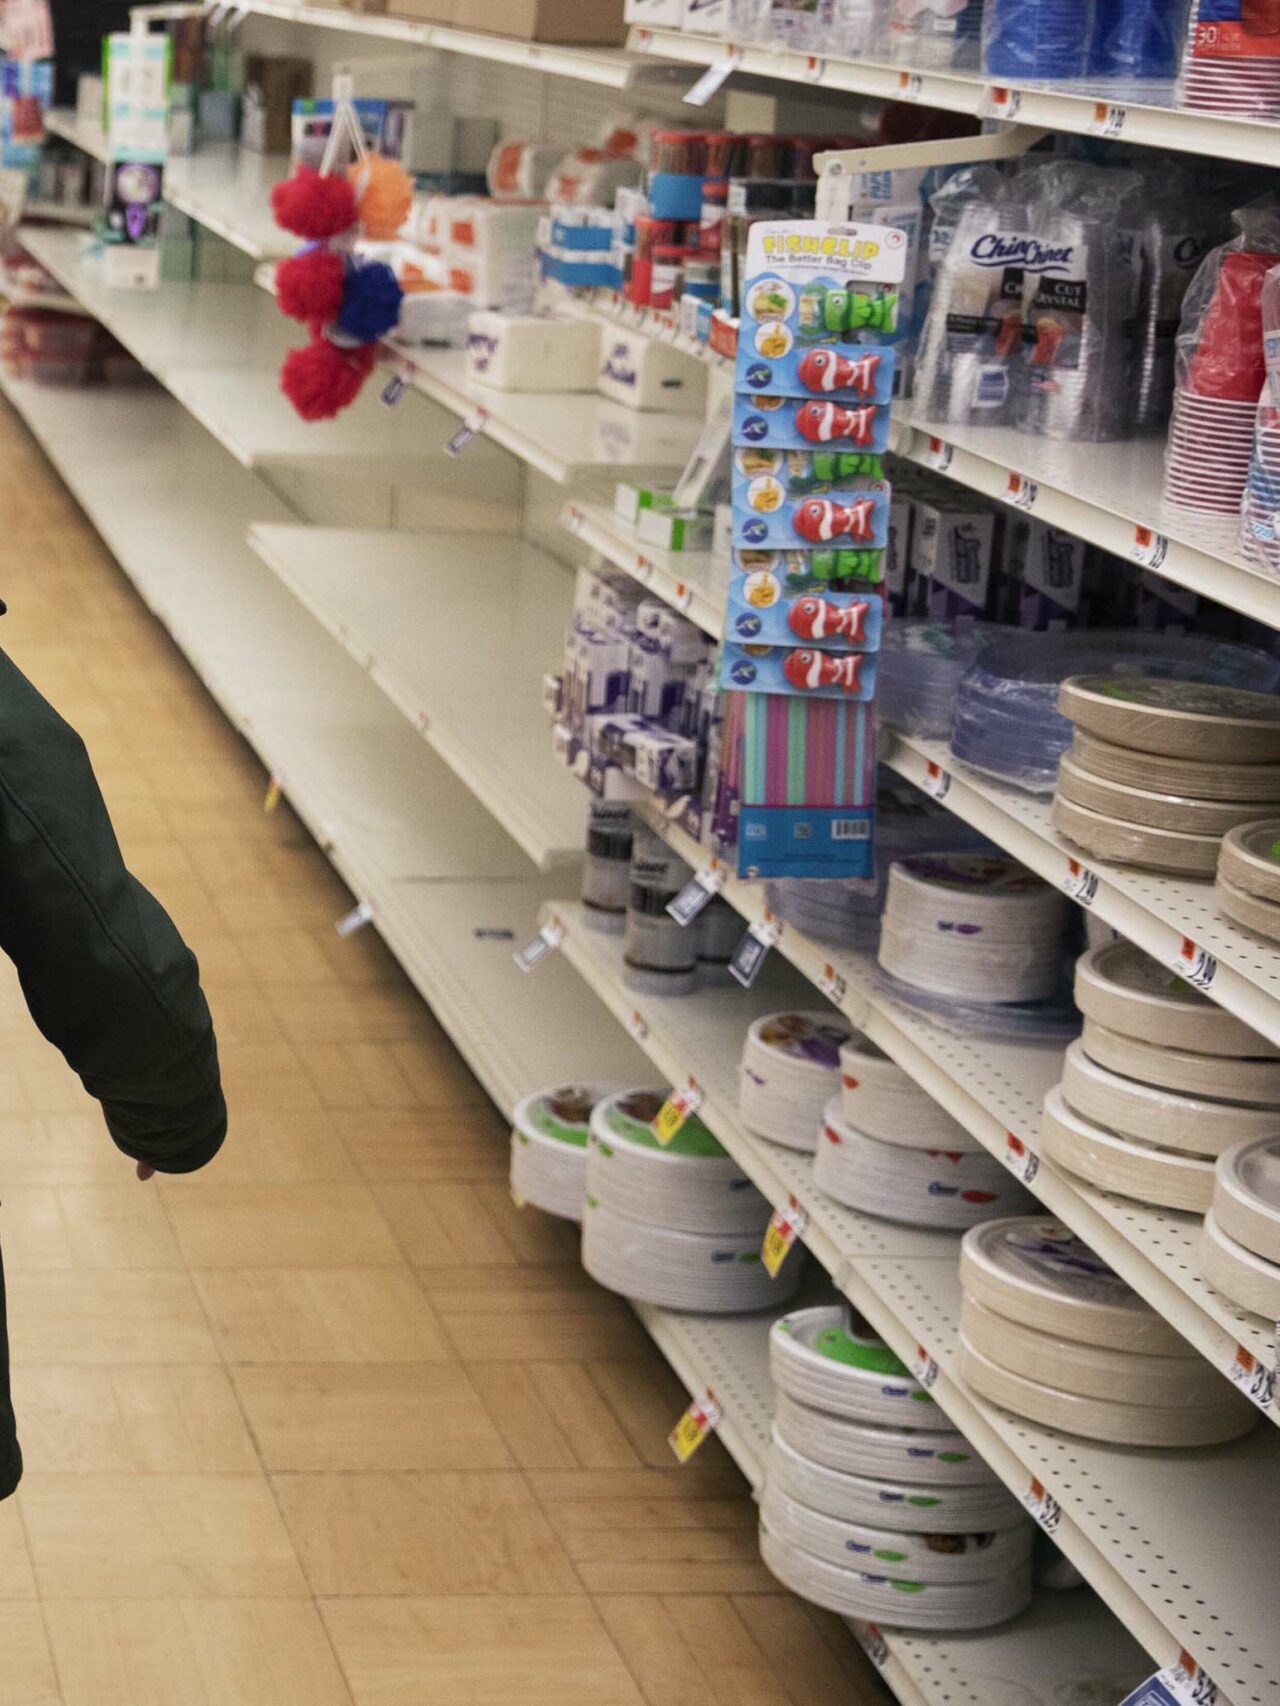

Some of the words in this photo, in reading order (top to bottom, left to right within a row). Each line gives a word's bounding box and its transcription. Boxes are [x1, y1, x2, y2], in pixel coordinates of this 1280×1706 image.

[766, 255, 785, 264] The
[788, 255, 822, 264] Better
[826, 257, 848, 269] Bag
